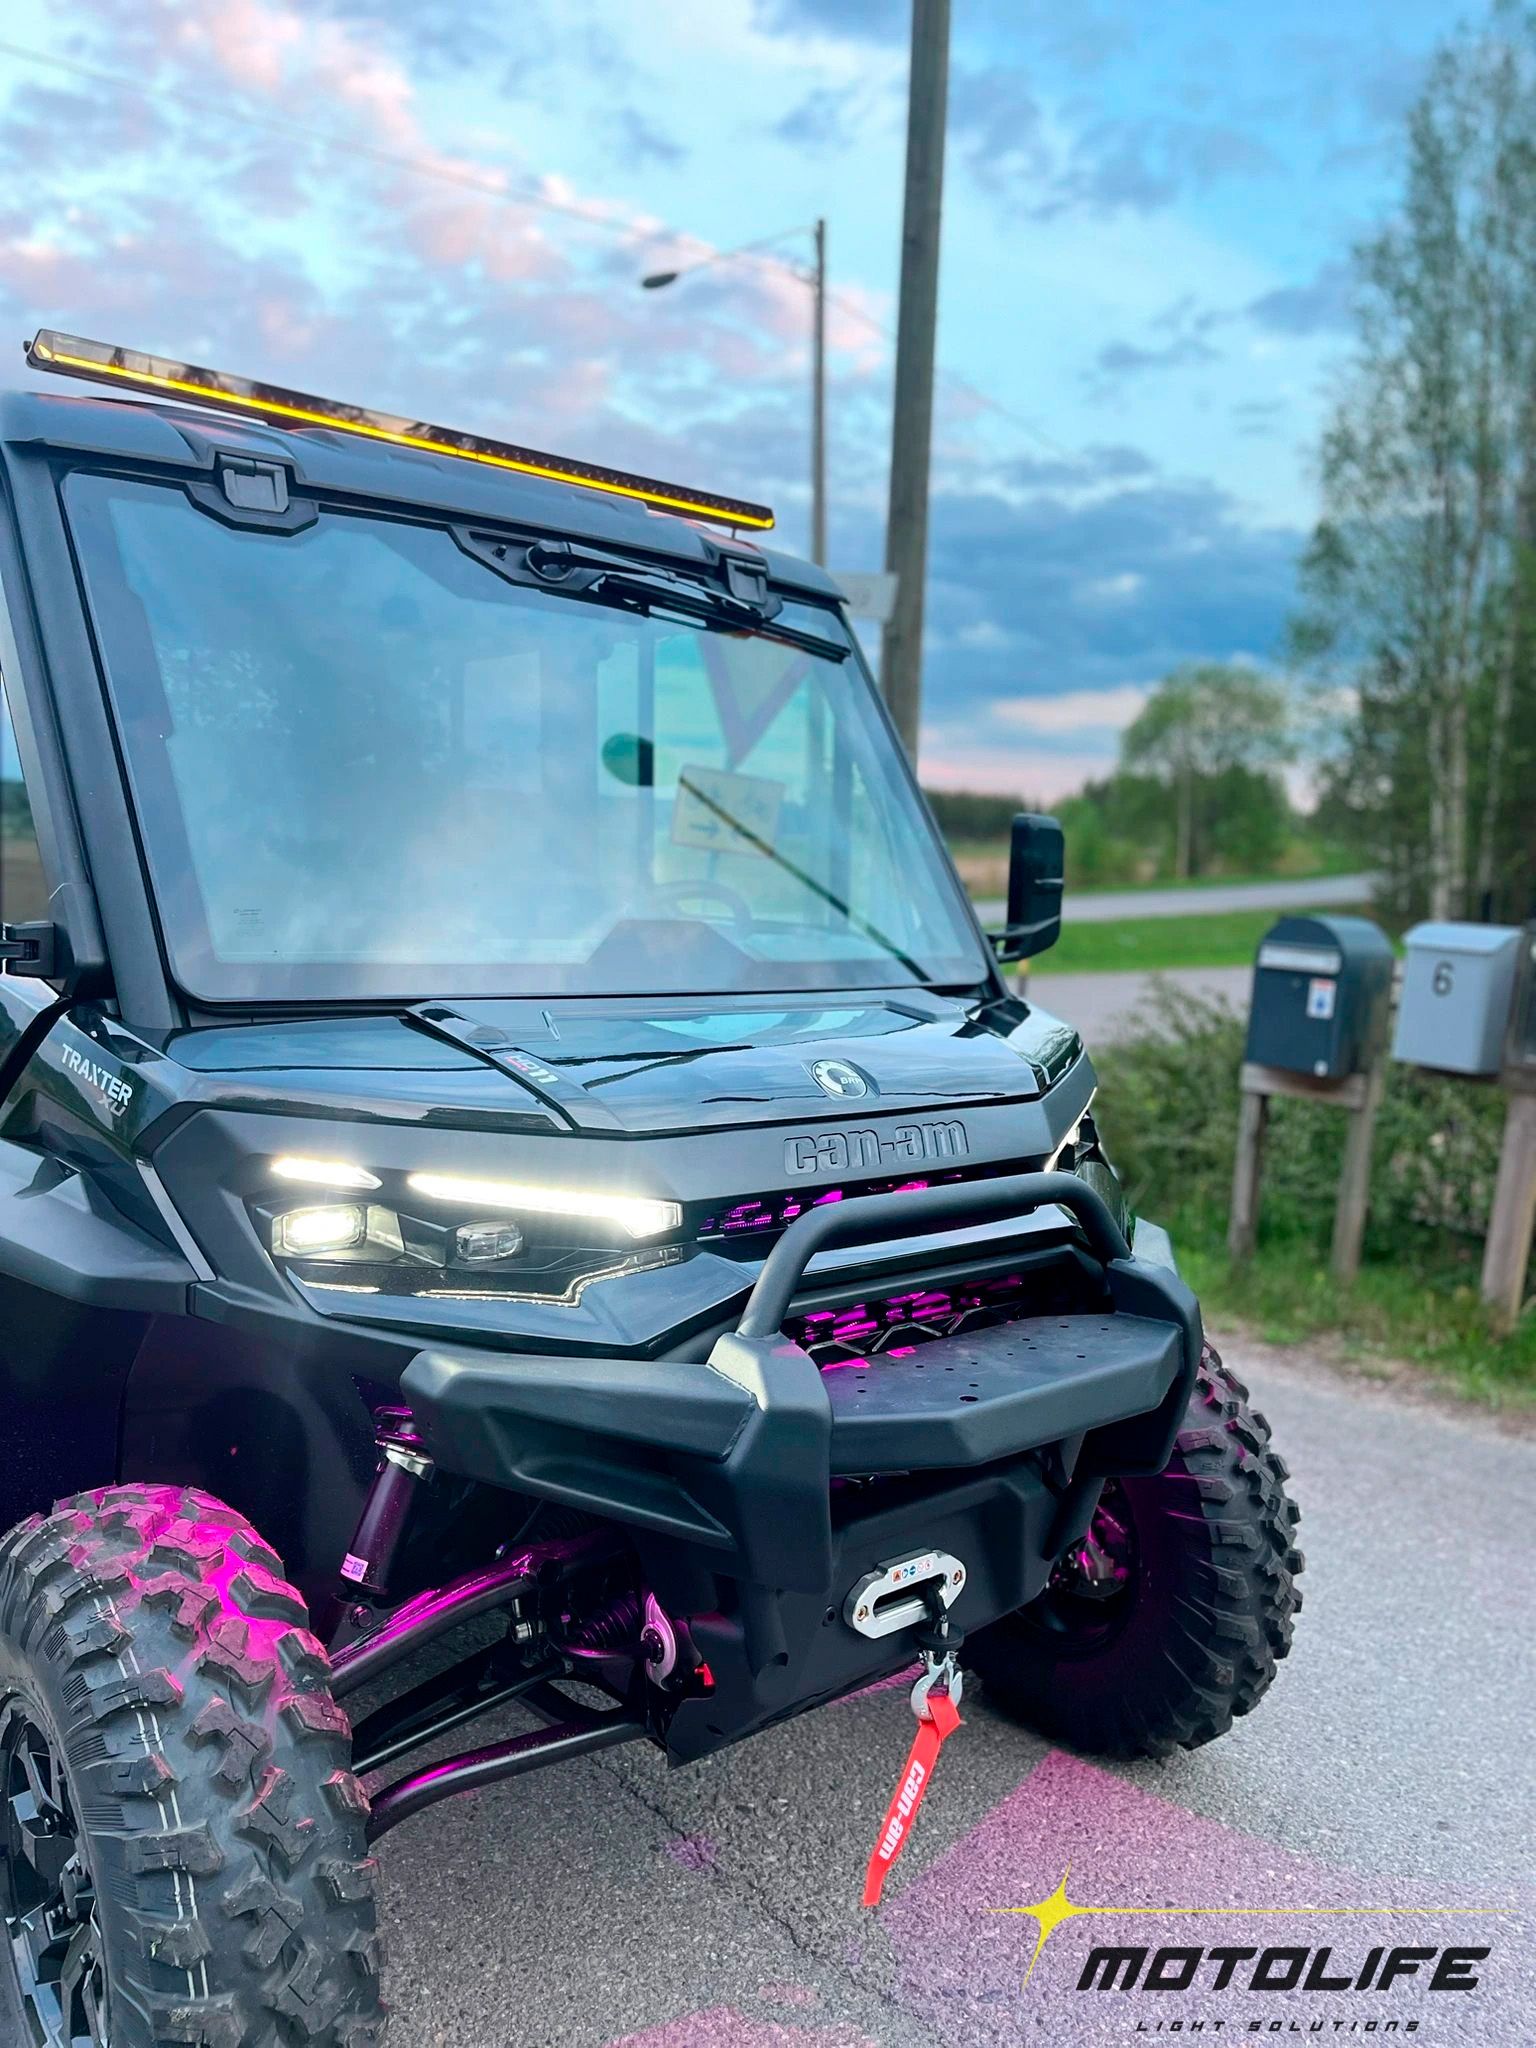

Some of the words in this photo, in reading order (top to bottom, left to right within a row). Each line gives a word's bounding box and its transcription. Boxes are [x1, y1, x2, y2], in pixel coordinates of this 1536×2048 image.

[1432, 961, 1454, 997] 6
[62, 1043, 133, 1107] TRAXTER
[97, 1093, 127, 1117] XU
